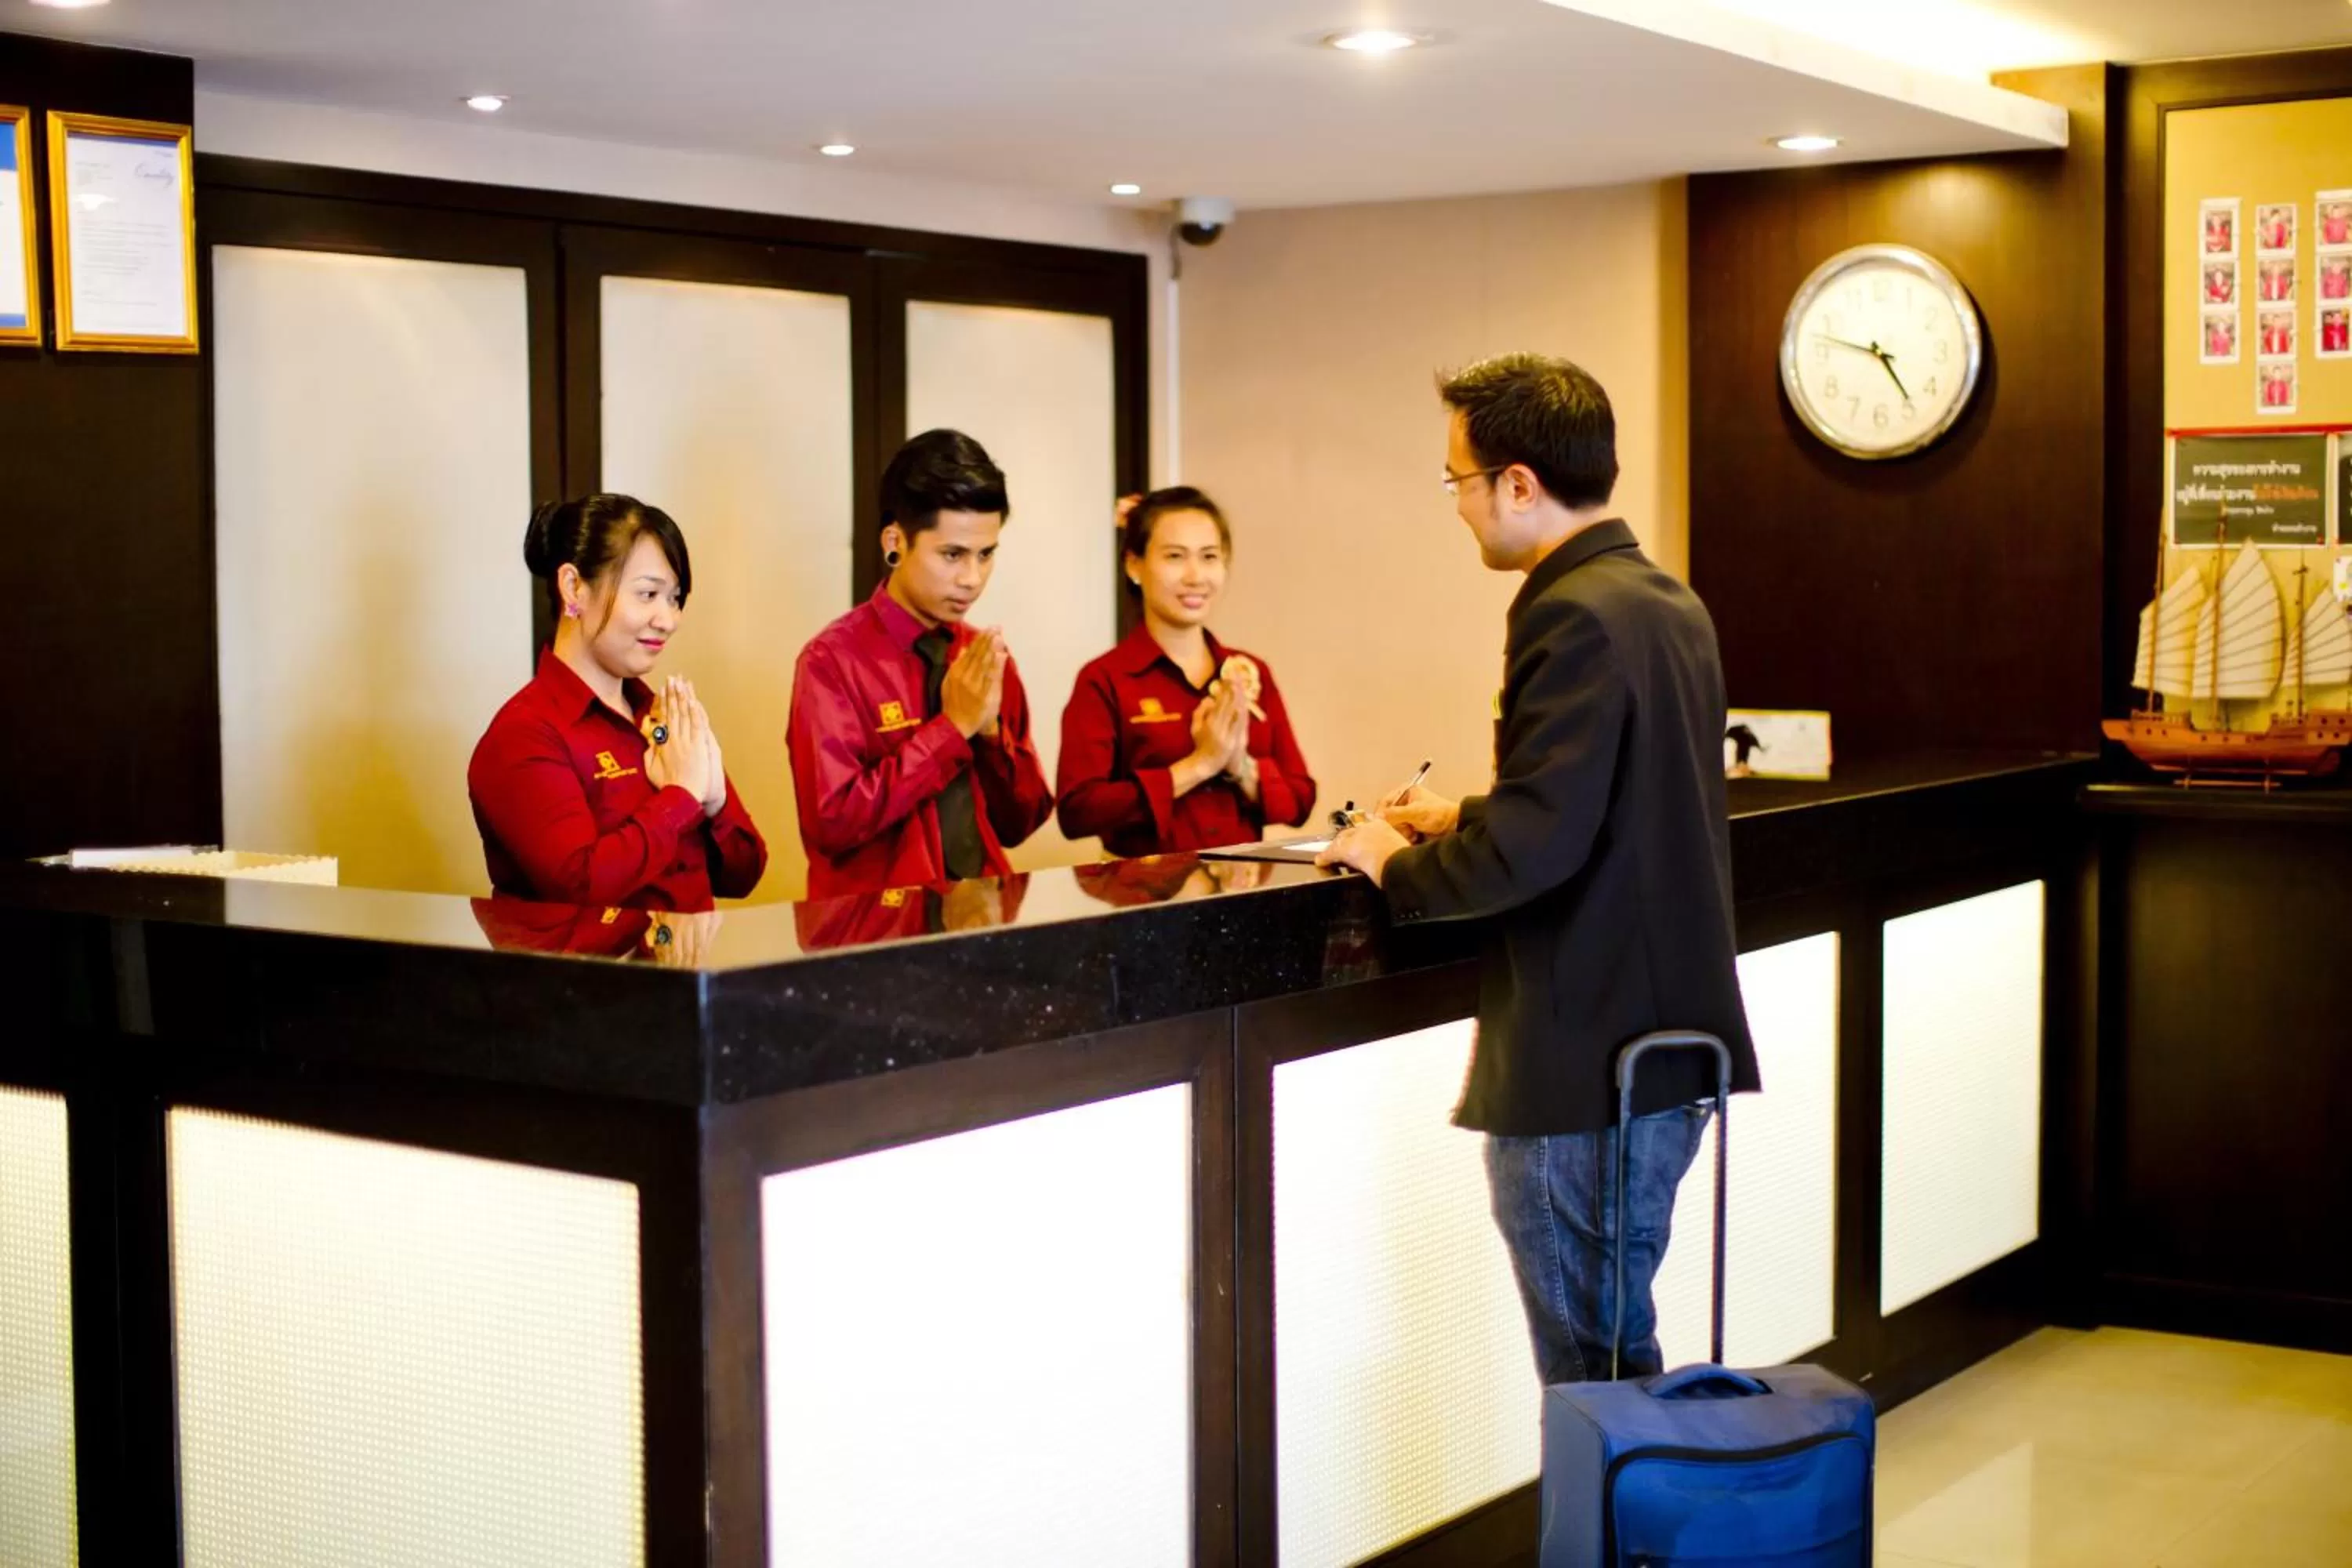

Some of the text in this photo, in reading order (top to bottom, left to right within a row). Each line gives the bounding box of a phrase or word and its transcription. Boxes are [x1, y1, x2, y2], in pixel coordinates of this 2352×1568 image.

[1922, 376, 1937, 397] 4
[1847, 396, 1861, 419] 7
[1873, 403, 1889, 429] 6
